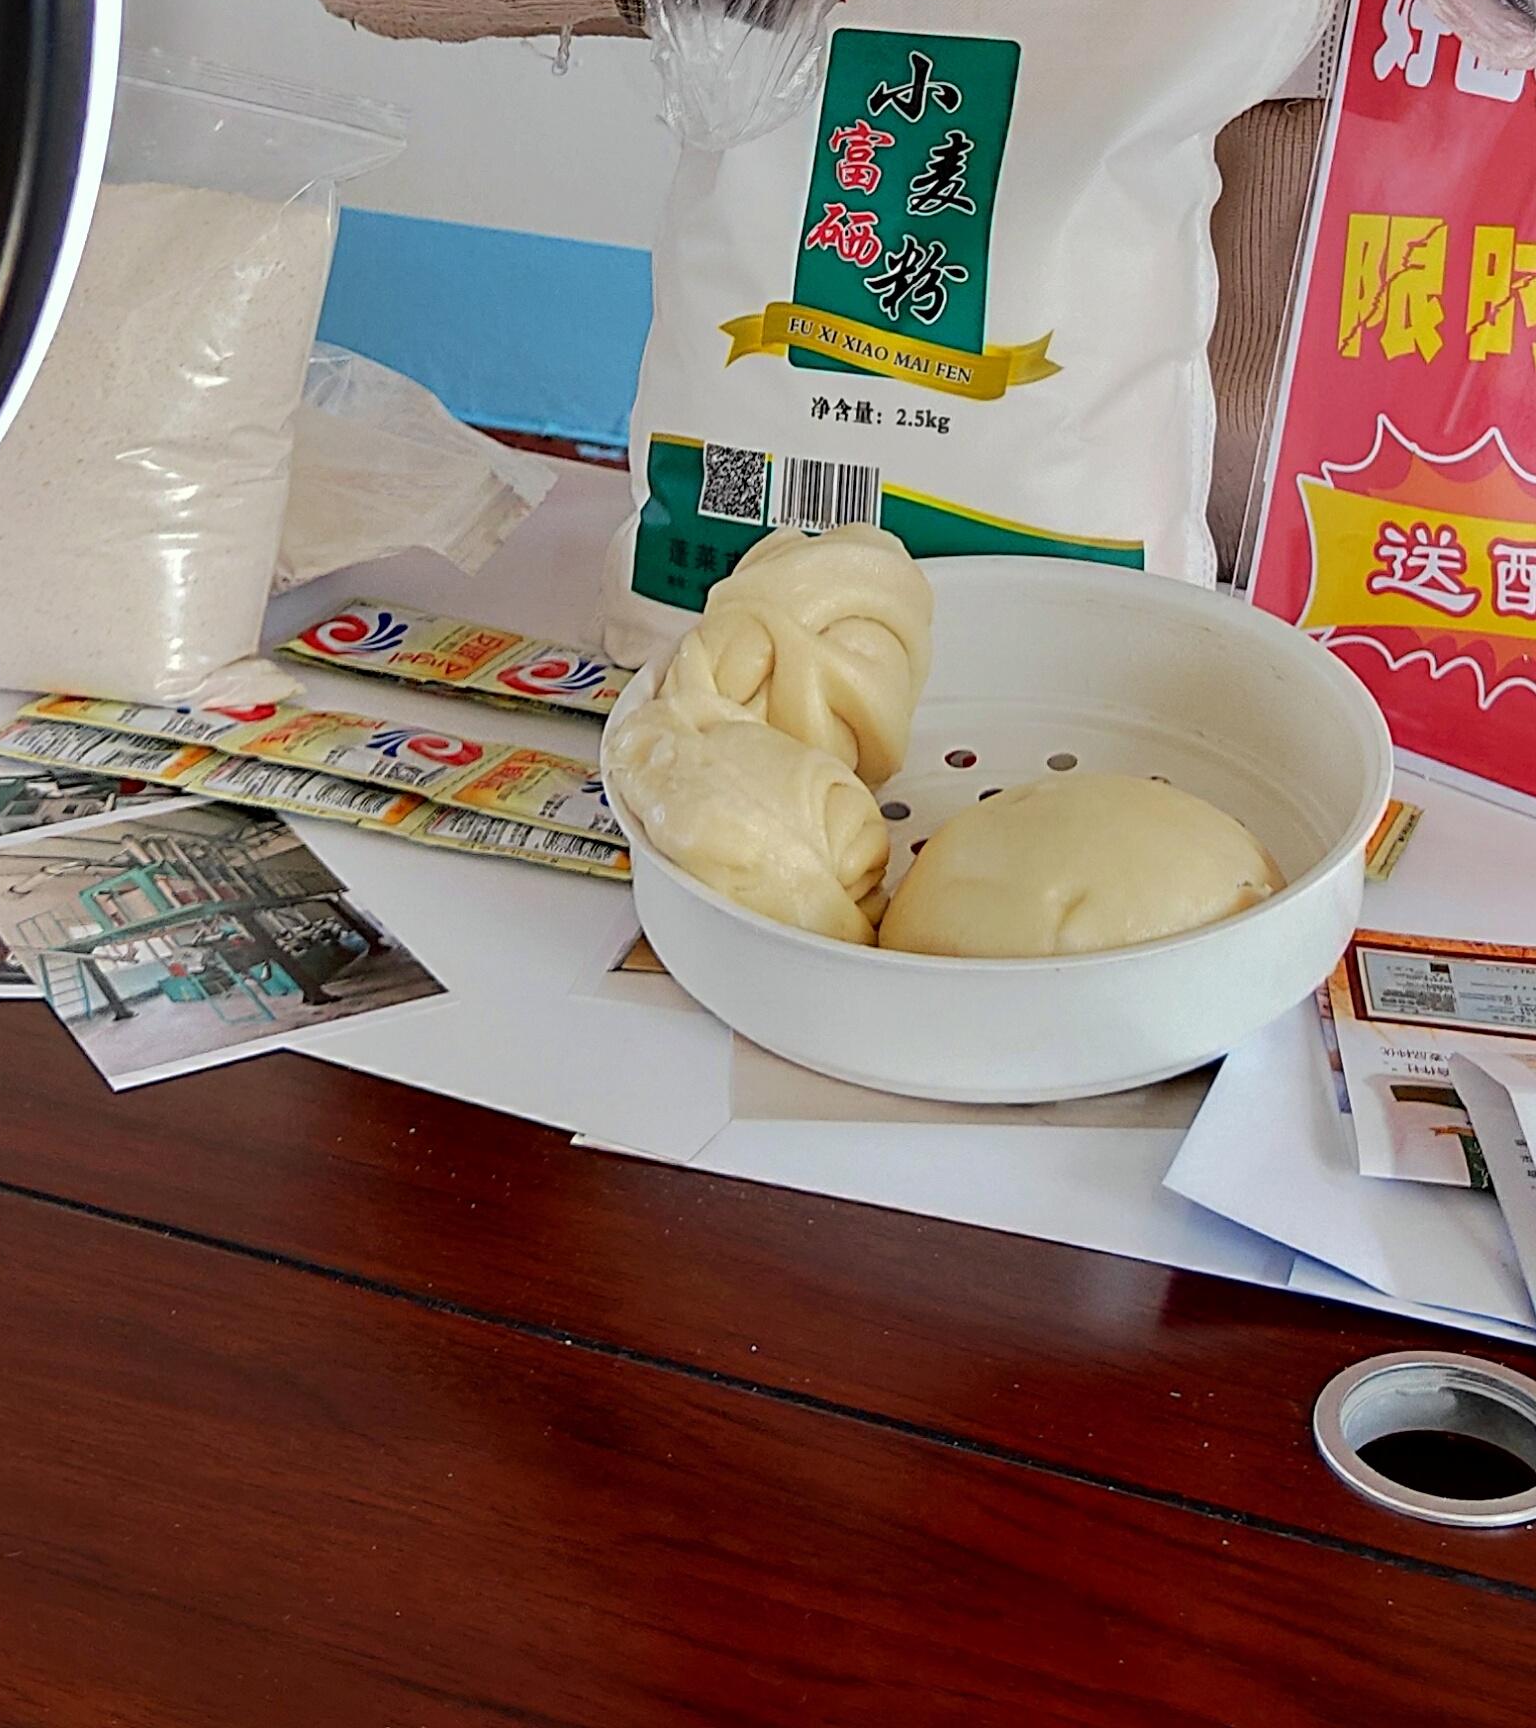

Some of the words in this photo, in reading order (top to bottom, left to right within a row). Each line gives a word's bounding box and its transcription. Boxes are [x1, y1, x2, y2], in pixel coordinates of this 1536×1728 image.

[804, 119, 895, 267] 富硒
[864, 51, 977, 324] 小麦粉
[789, 317, 814, 335] FU
[818, 325, 839, 345] XI
[842, 334, 889, 362] XIAO
[893, 351, 931, 375] MAI
[935, 362, 973, 385] FEN
